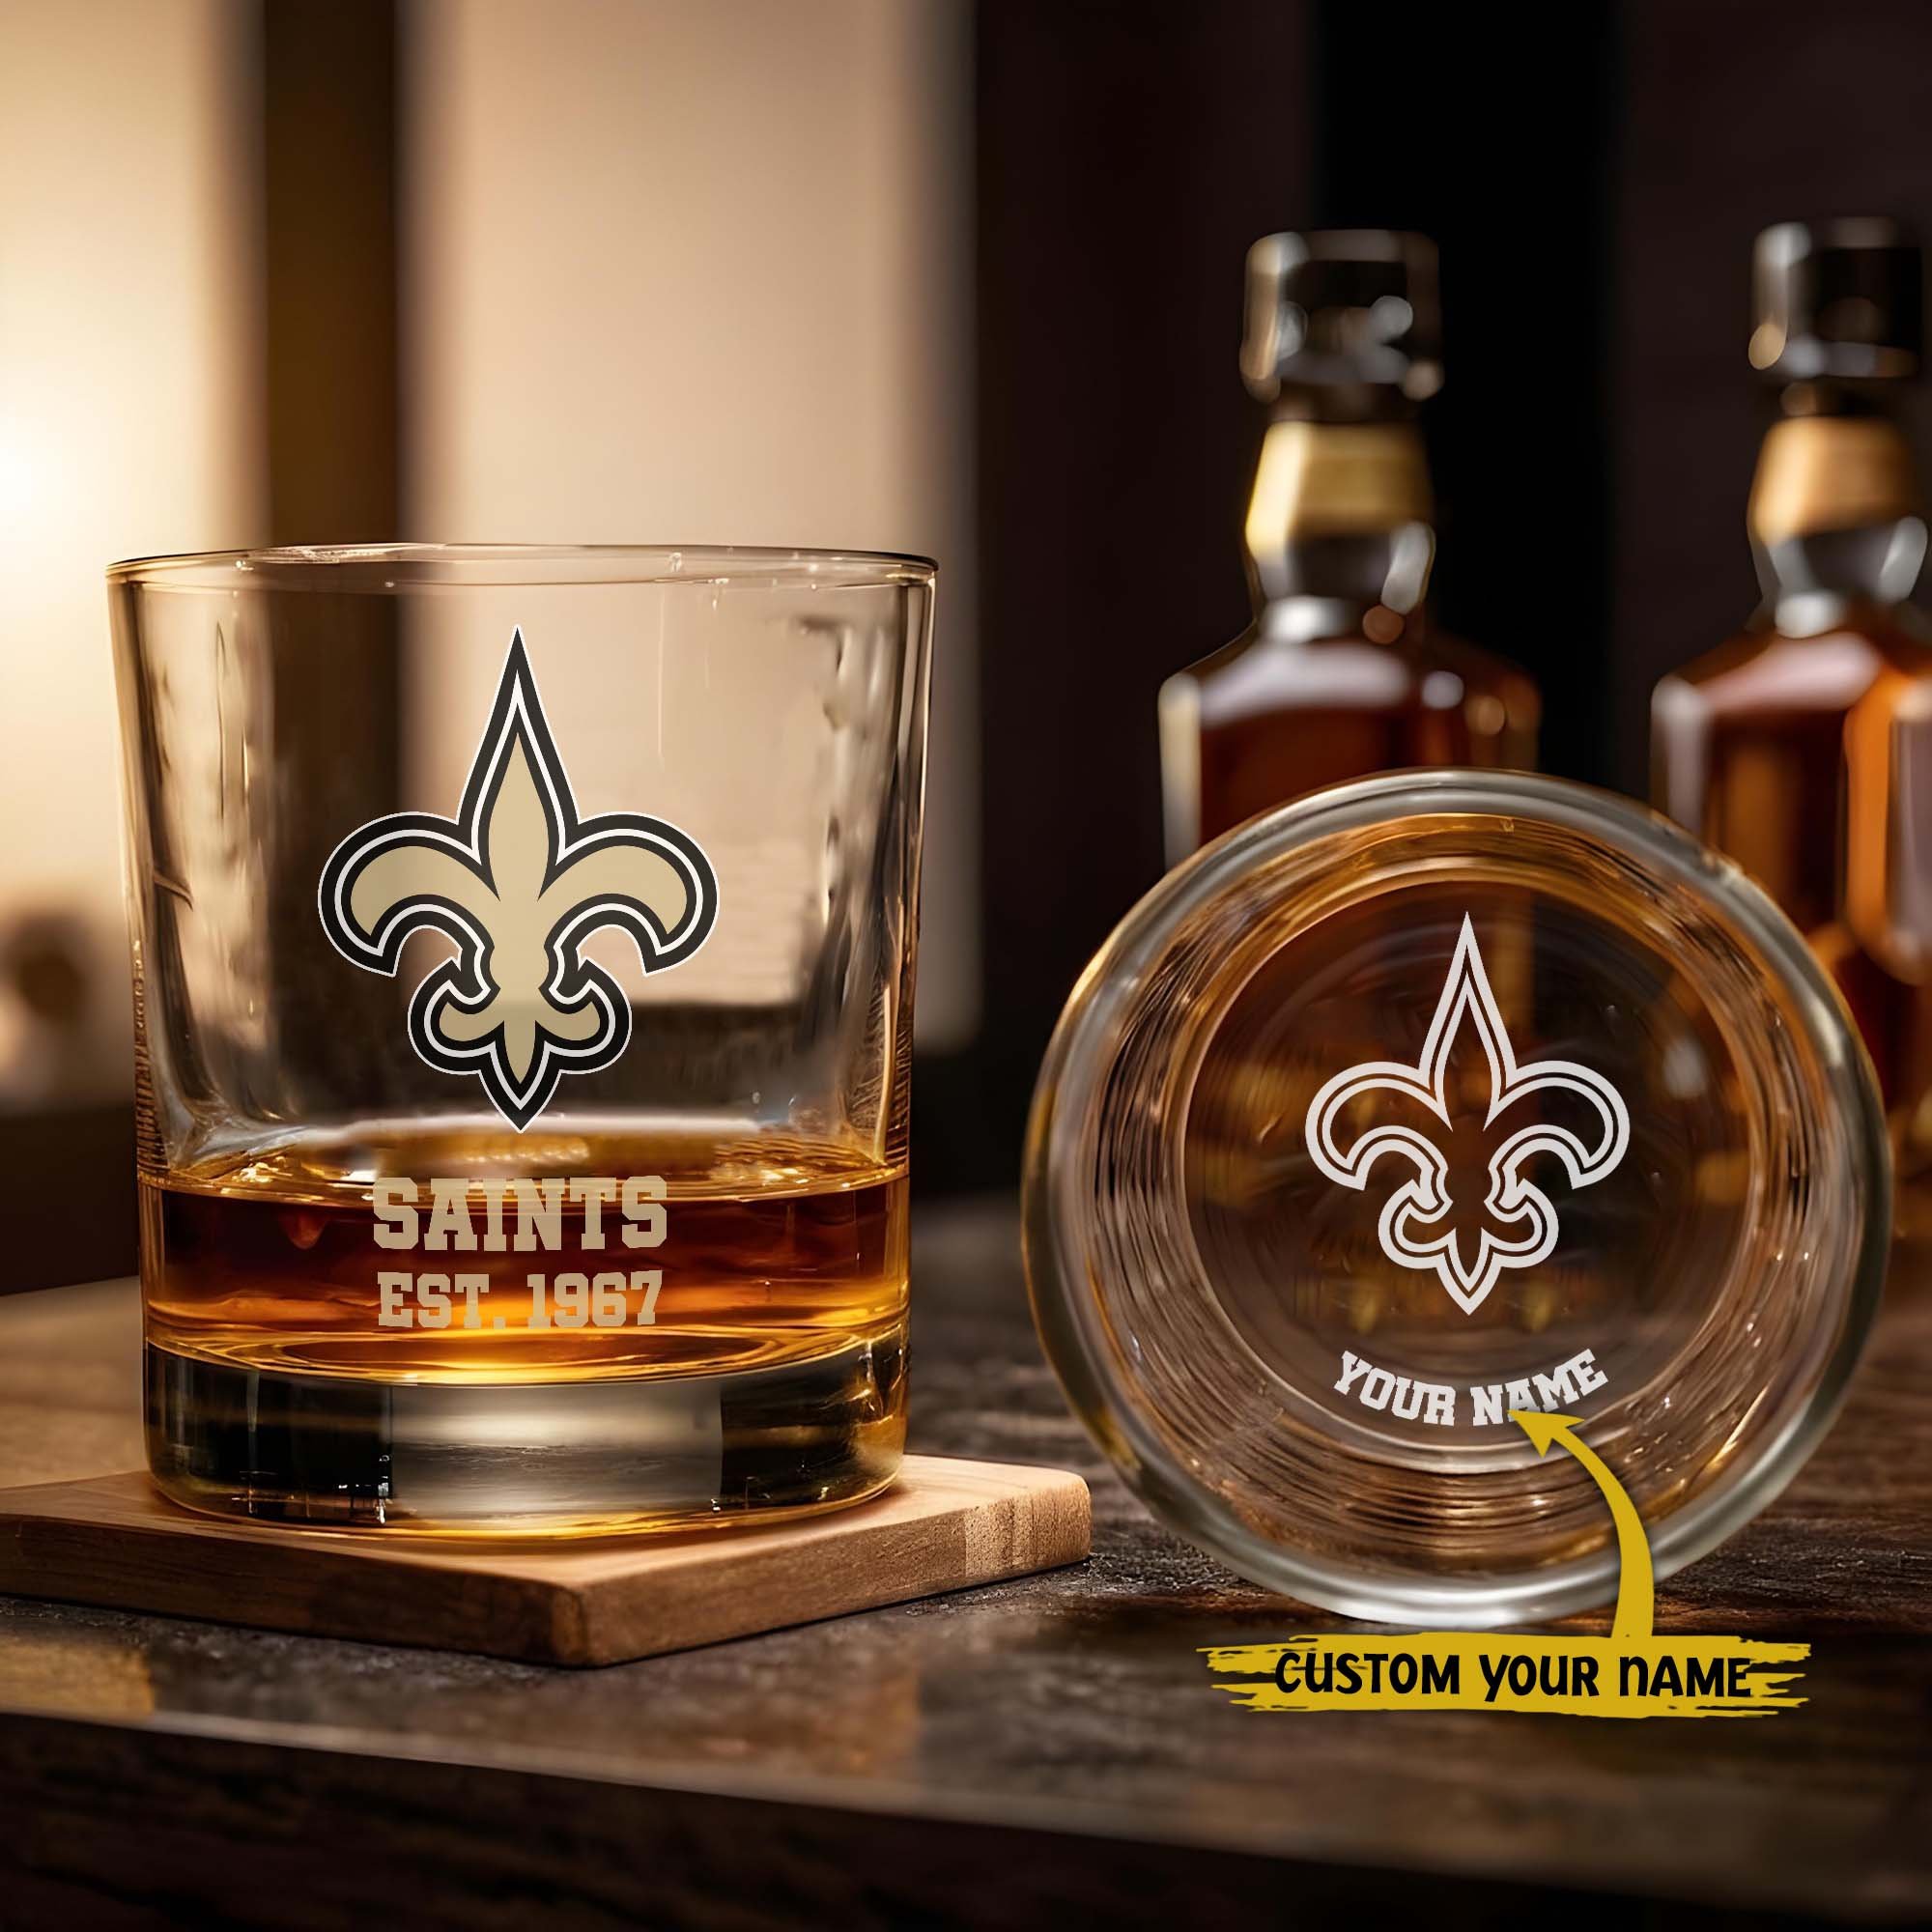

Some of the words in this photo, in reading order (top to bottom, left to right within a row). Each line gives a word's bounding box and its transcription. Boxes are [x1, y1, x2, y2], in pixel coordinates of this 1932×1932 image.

[373, 1176, 668, 1252] SAINTS
[377, 1271, 506, 1329] EST.
[526, 1269, 663, 1330] 1967
[1333, 1350, 1457, 1427] YOUR
[1469, 1348, 1609, 1427] NAME
